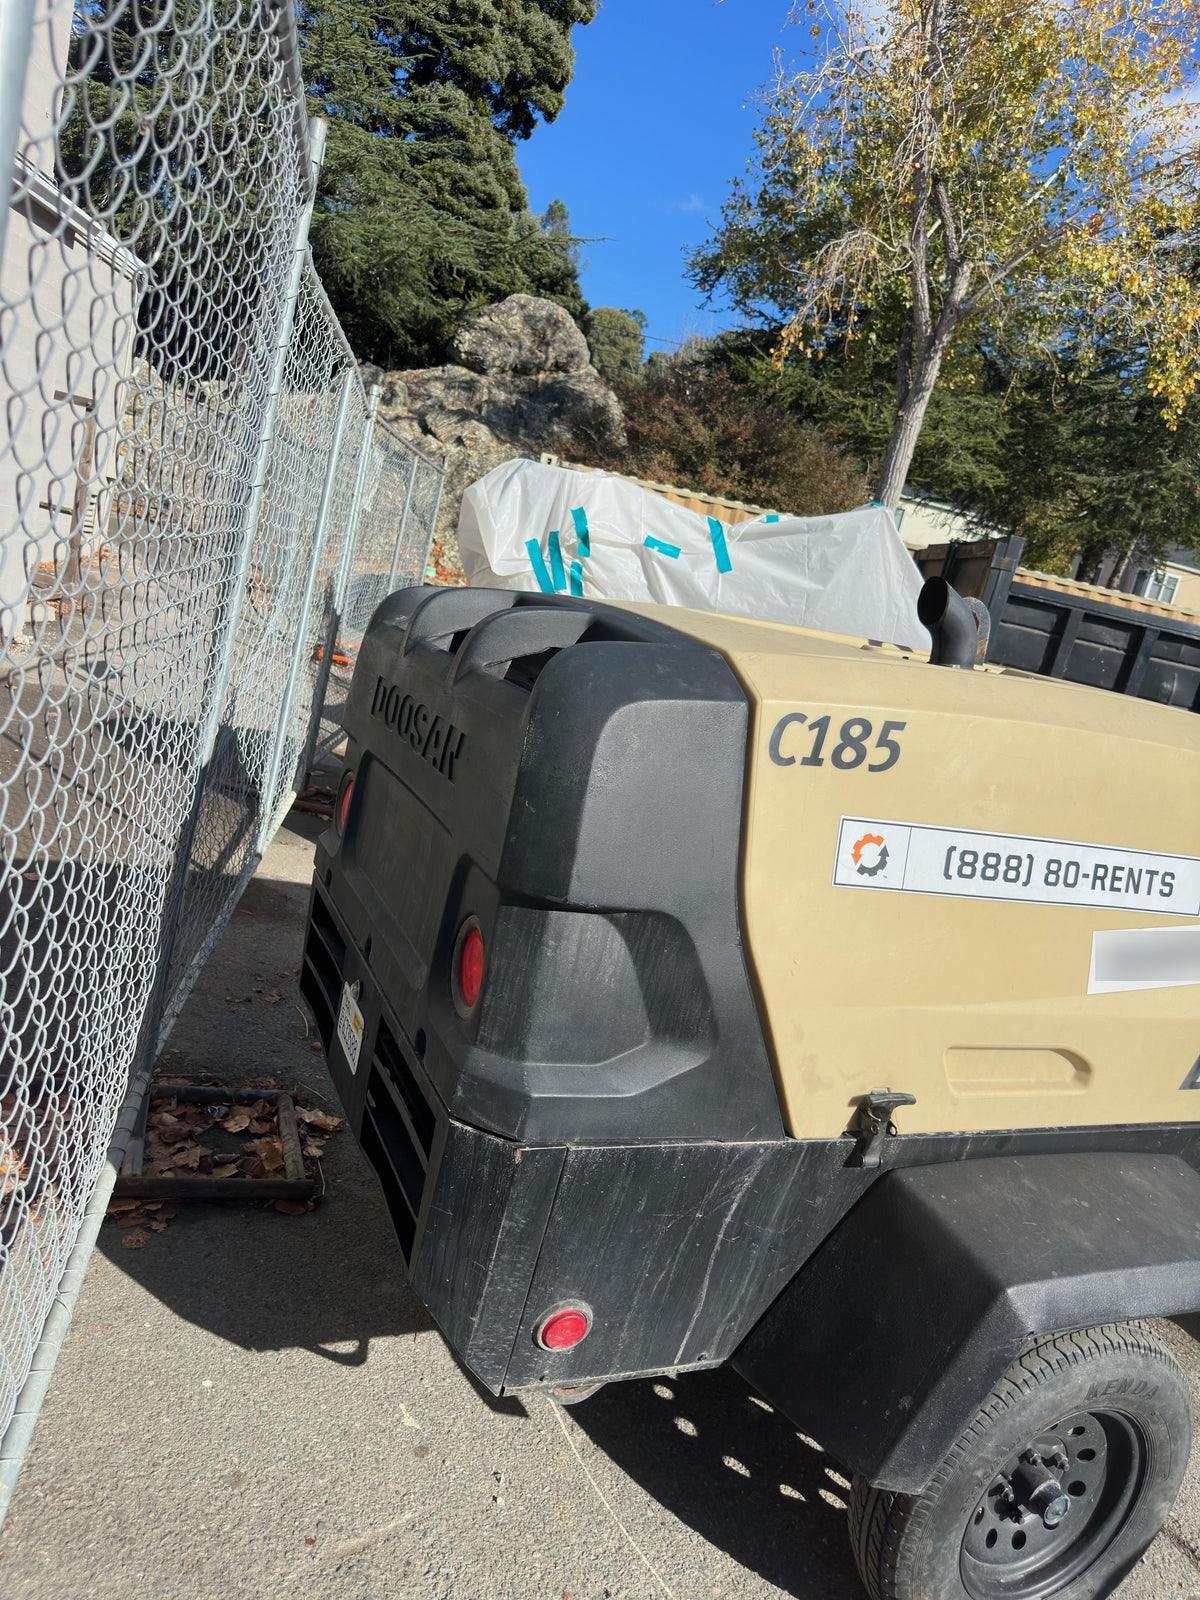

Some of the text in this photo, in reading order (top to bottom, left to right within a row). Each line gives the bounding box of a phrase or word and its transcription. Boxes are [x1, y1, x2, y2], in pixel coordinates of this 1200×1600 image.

[370, 674, 467, 784] DOOSAN
[768, 712, 907, 773] C185
[943, 846, 1176, 898] (888) 80-RENTS
[1084, 1377, 1159, 1401] KENDA
